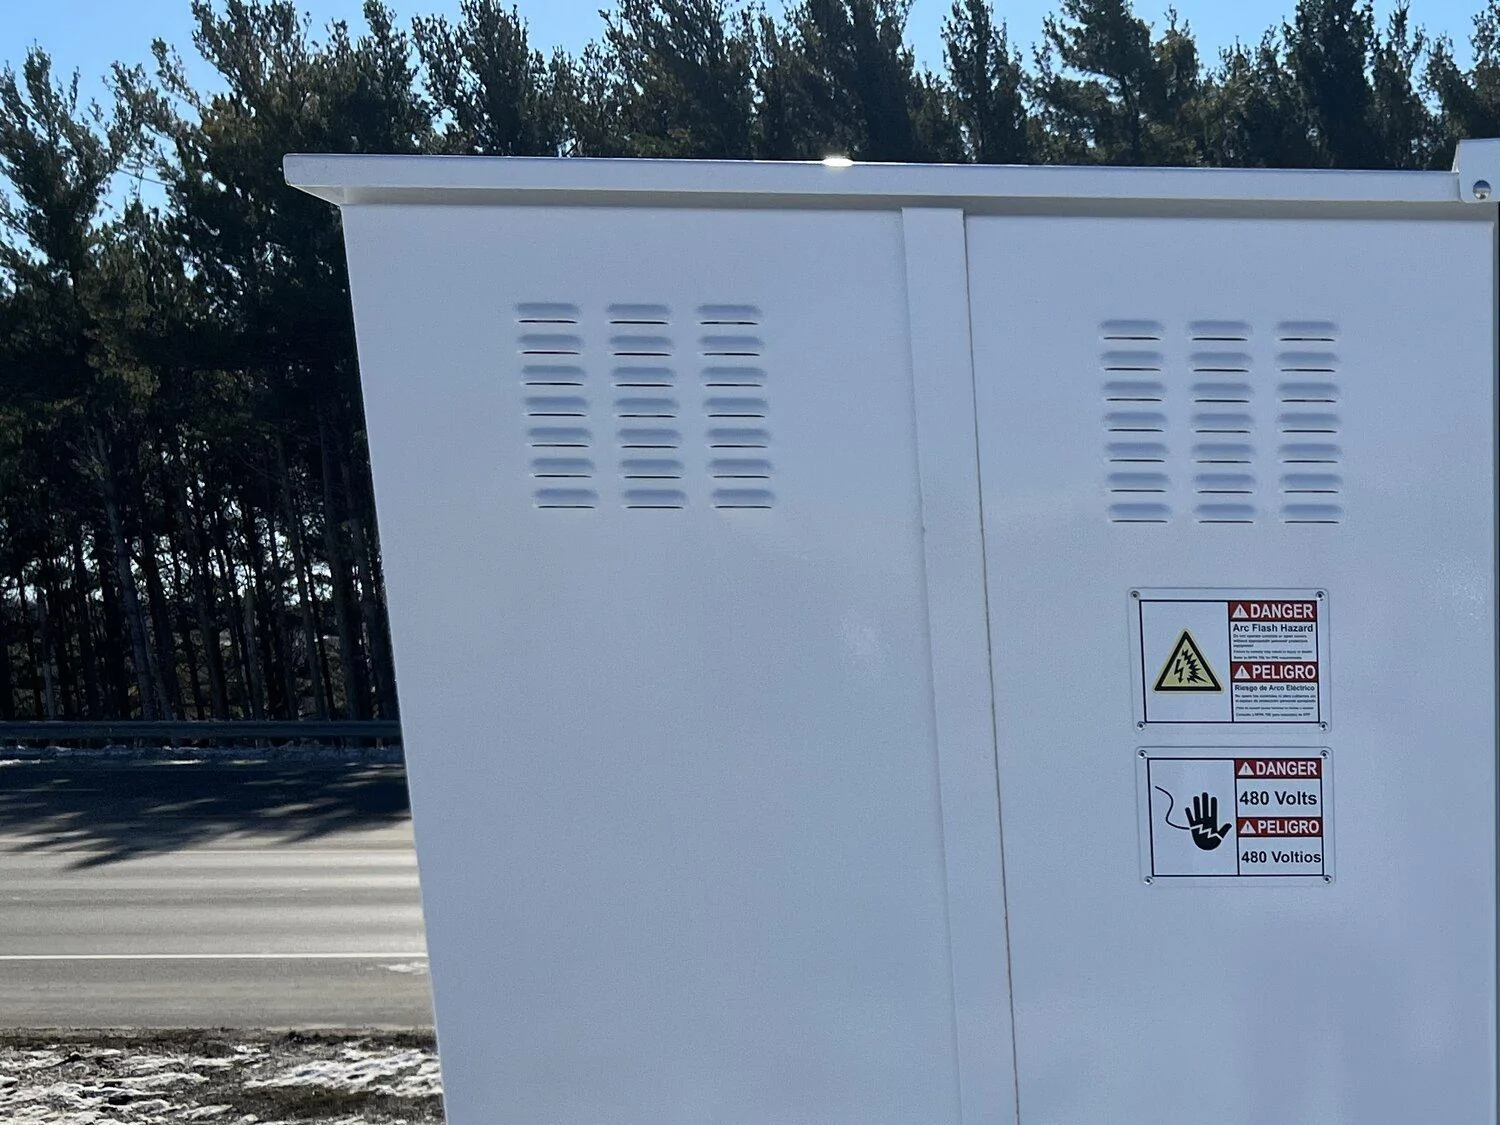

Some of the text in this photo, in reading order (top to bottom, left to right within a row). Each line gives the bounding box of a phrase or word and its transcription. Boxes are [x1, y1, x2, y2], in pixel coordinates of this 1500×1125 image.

[1250, 603, 1313, 619] DANGER
[1232, 623, 1314, 633] Arc Flash Hazard
[1252, 665, 1316, 680] PELIGRO
[1234, 684, 1258, 692] Riesgo
[1256, 761, 1317, 776] DANGER
[1239, 790, 1317, 806] 480 Volts
[1257, 820, 1320, 834] PELIGRO
[1241, 850, 1321, 863] 480 Voltios
